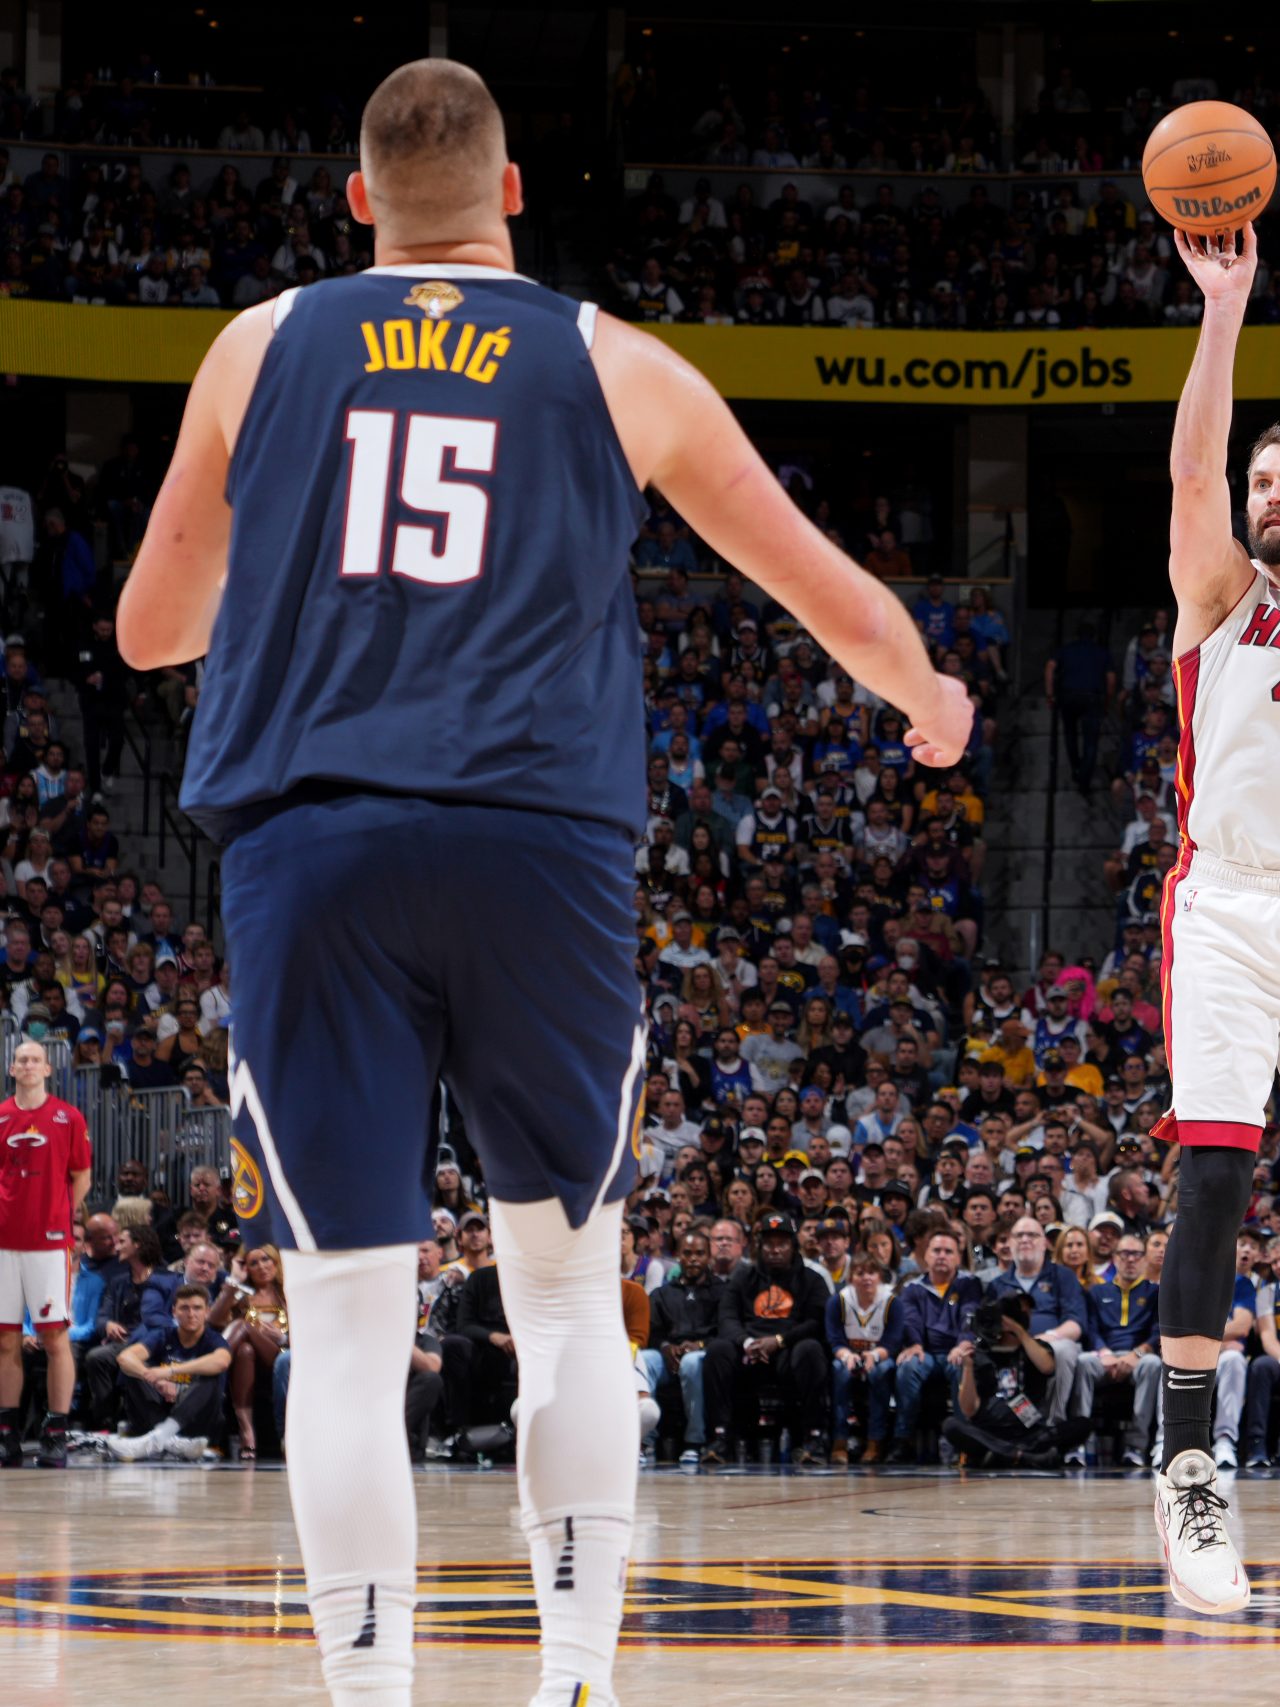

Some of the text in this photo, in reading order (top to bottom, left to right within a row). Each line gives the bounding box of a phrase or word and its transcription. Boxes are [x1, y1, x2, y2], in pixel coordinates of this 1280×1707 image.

[1172, 186, 1261, 217] Wilson
[362, 319, 511, 383] JOKIĆ
[816, 347, 1132, 398] wu.com/jobs
[339, 409, 498, 586] 15
